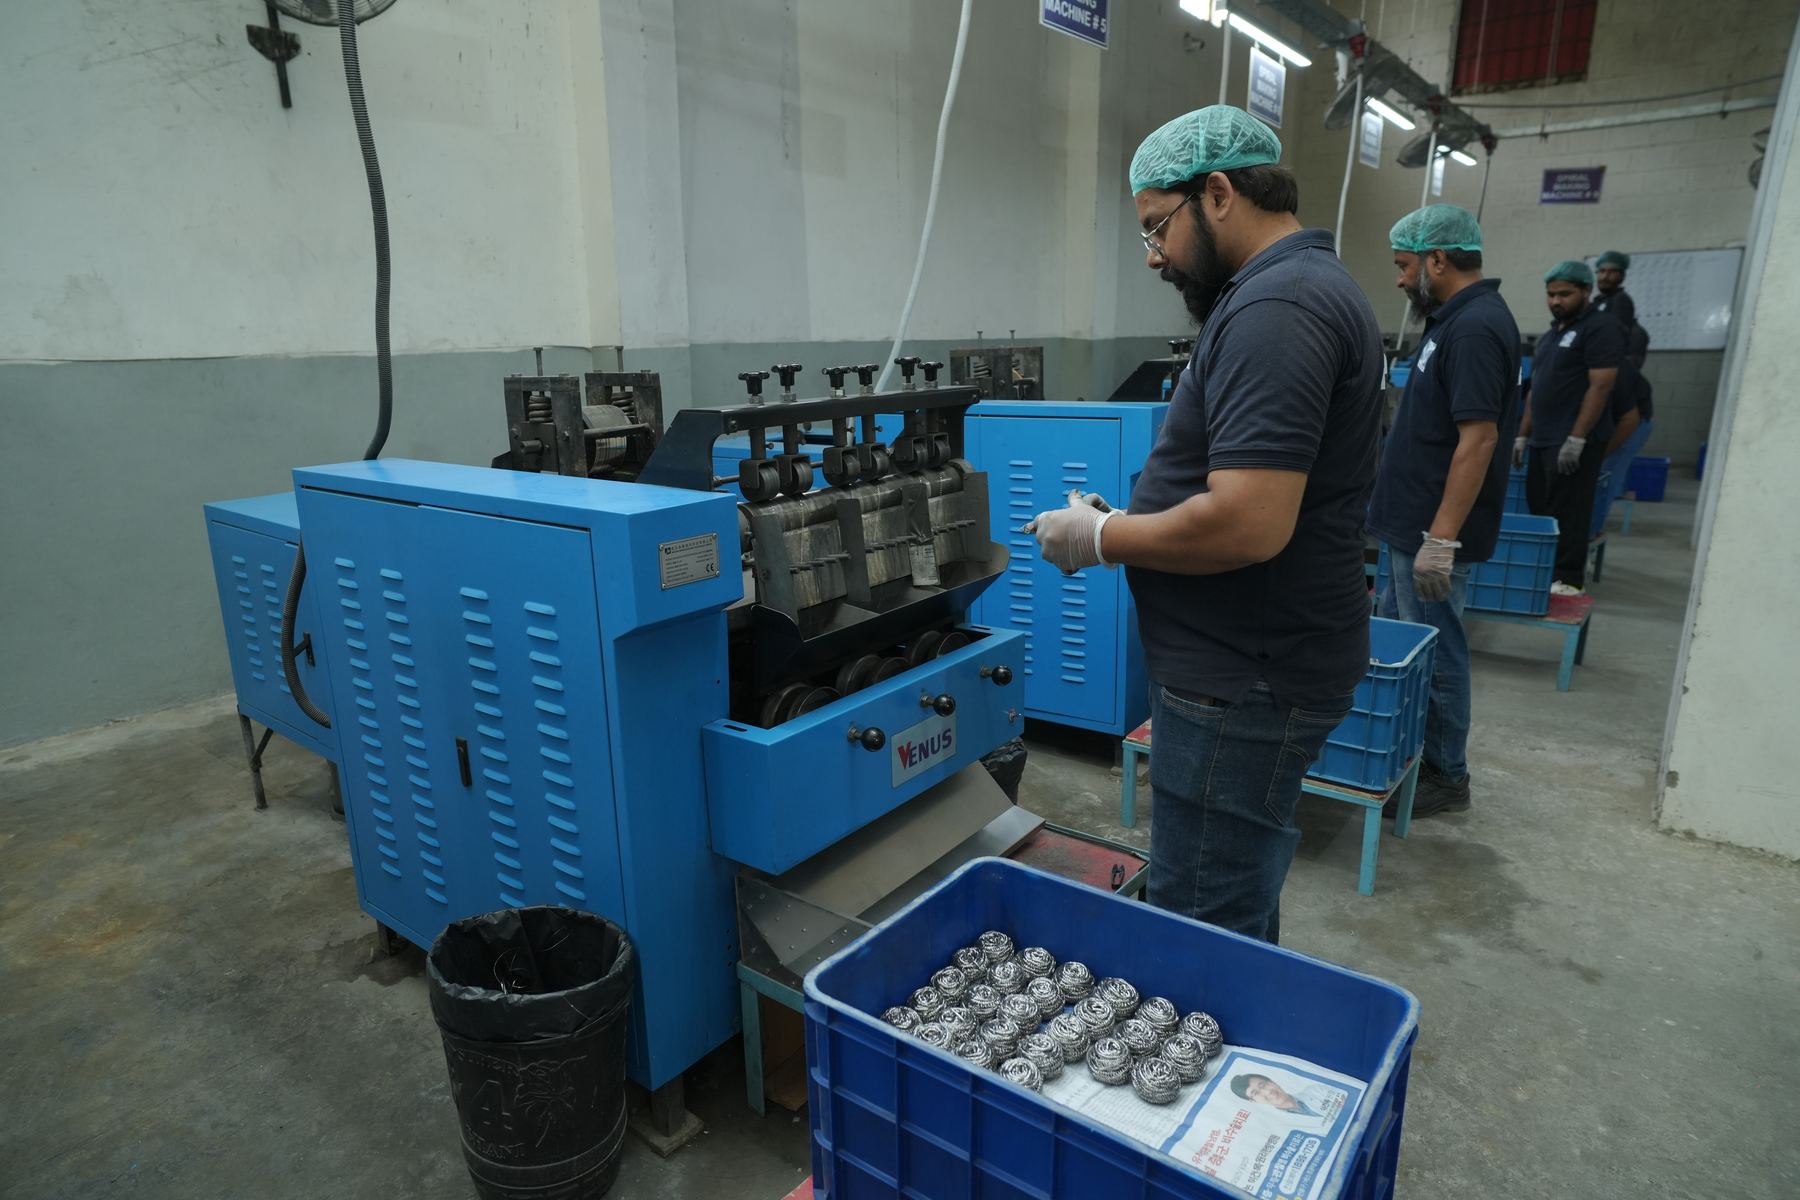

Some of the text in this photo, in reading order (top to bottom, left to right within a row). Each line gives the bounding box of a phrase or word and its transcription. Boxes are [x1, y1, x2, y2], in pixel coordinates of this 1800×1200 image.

[1044, 0, 1091, 27] MACHINE
[1092, 15, 1099, 30] #
[1100, 17, 1107, 33] 5
[897, 728, 952, 770] VENUS
